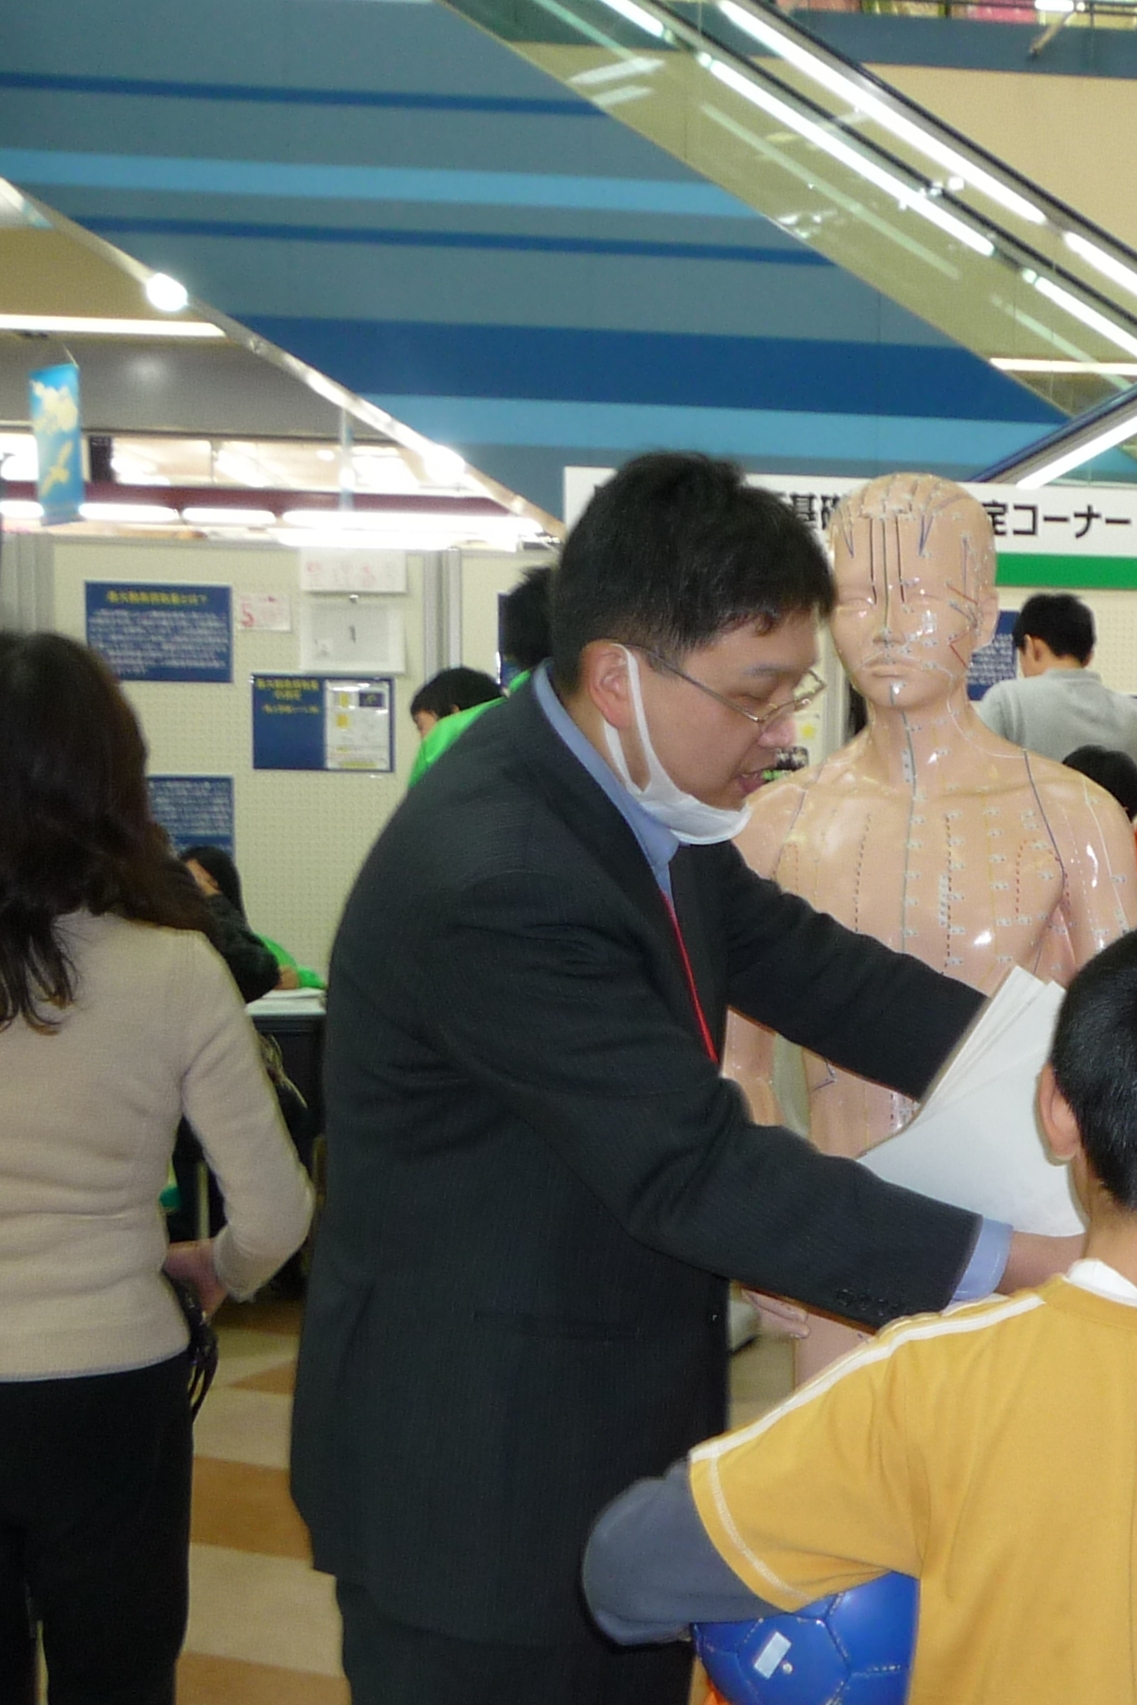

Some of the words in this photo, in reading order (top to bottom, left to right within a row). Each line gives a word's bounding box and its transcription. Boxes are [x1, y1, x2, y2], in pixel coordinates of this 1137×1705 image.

[981, 500, 1132, 538] 定コーナー
